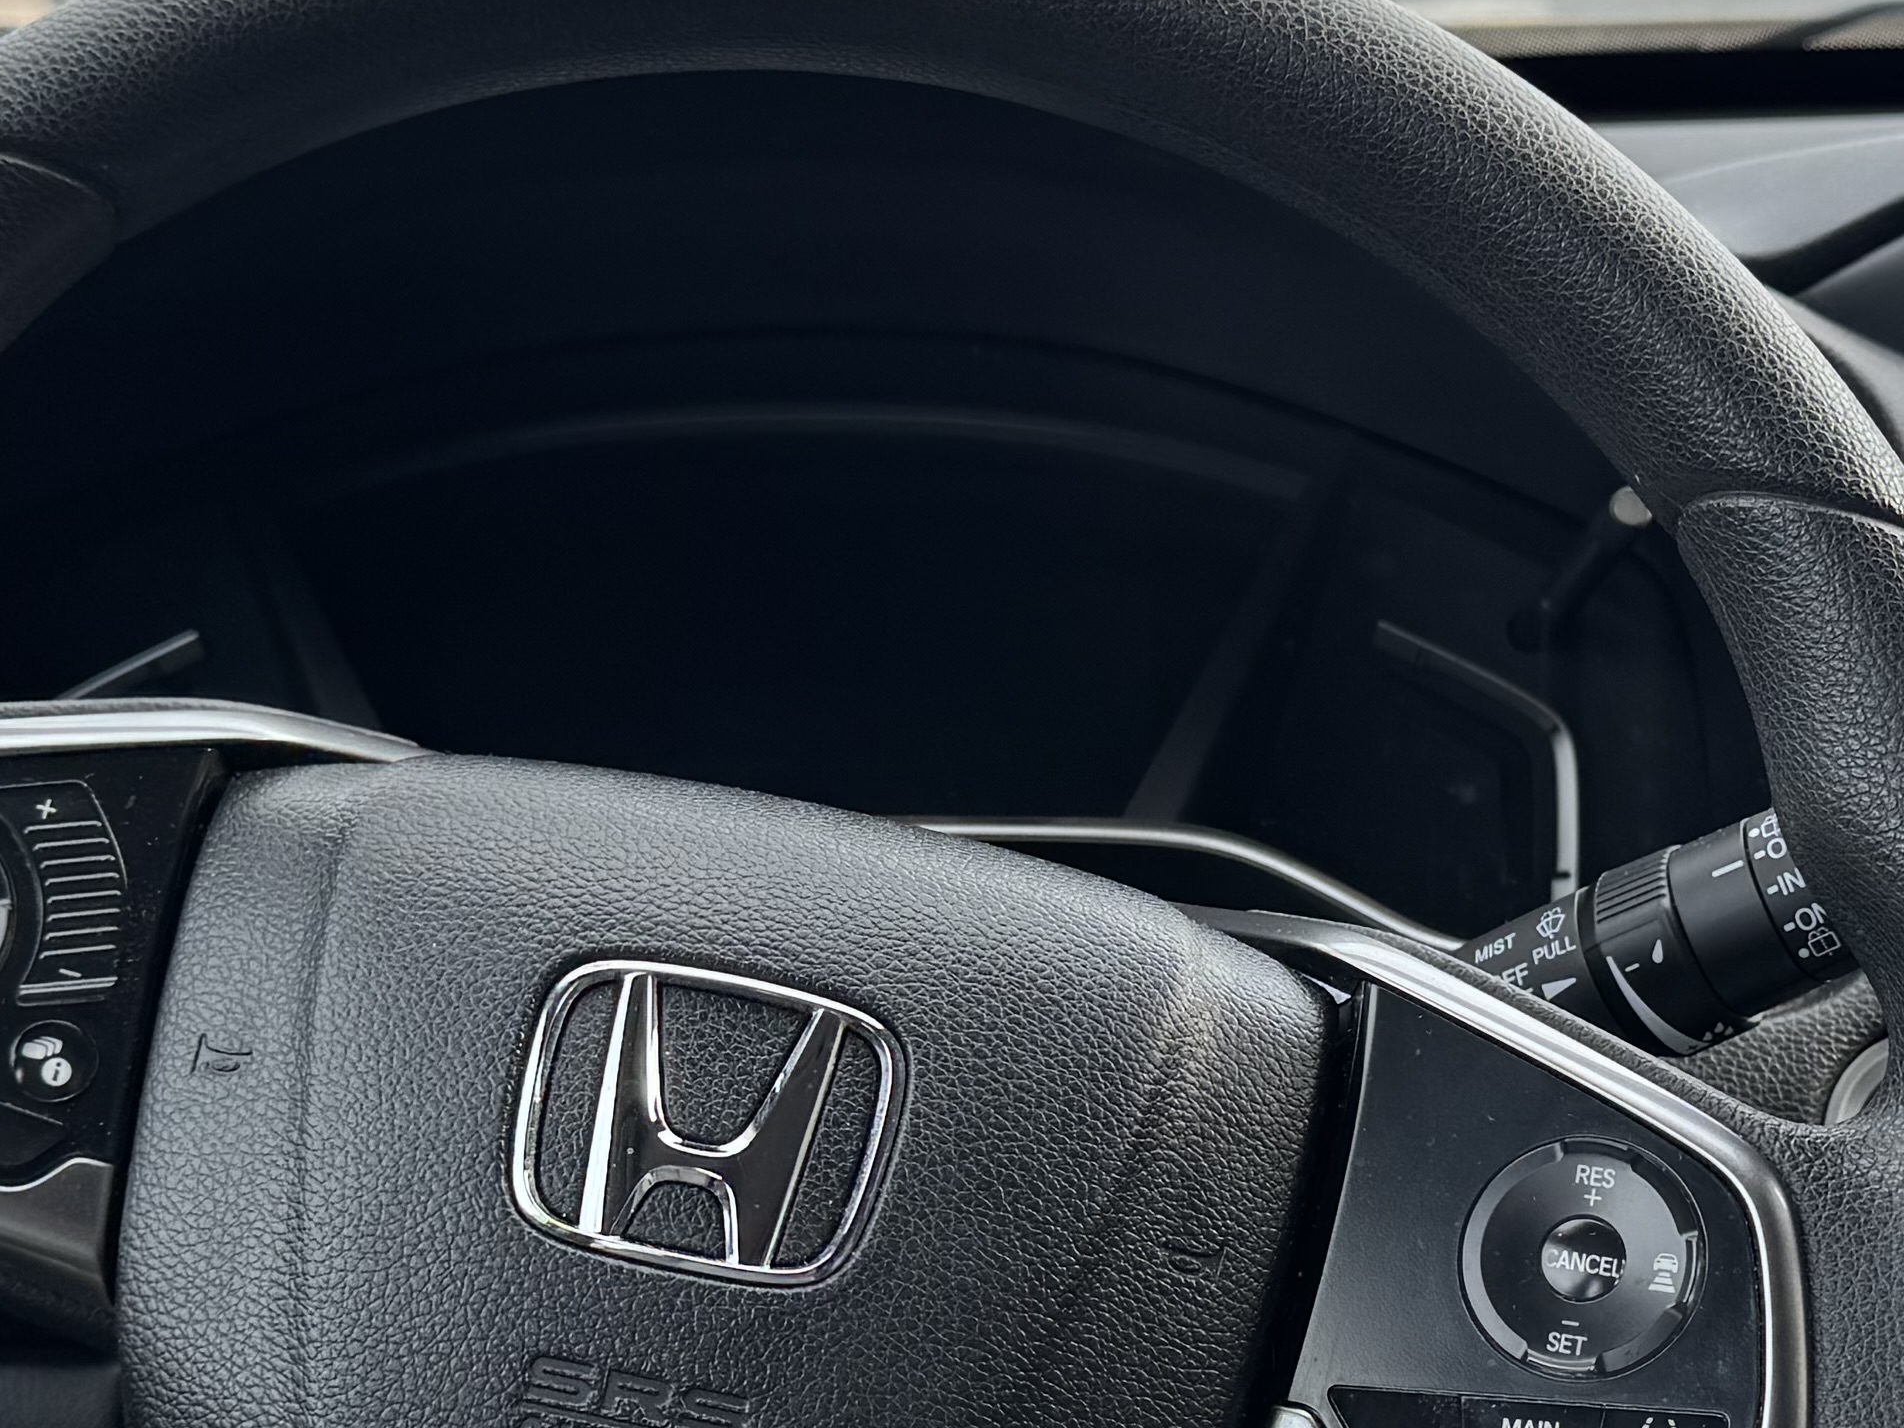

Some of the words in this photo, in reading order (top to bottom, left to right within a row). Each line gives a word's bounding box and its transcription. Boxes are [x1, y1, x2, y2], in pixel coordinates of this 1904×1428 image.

[1474, 932, 1516, 964] MIST
[1532, 936, 1577, 965] PULL
[1575, 1164, 1616, 1189] RES
[1545, 1248, 1620, 1279] CANCEL
[1546, 1331, 1588, 1356] SET
